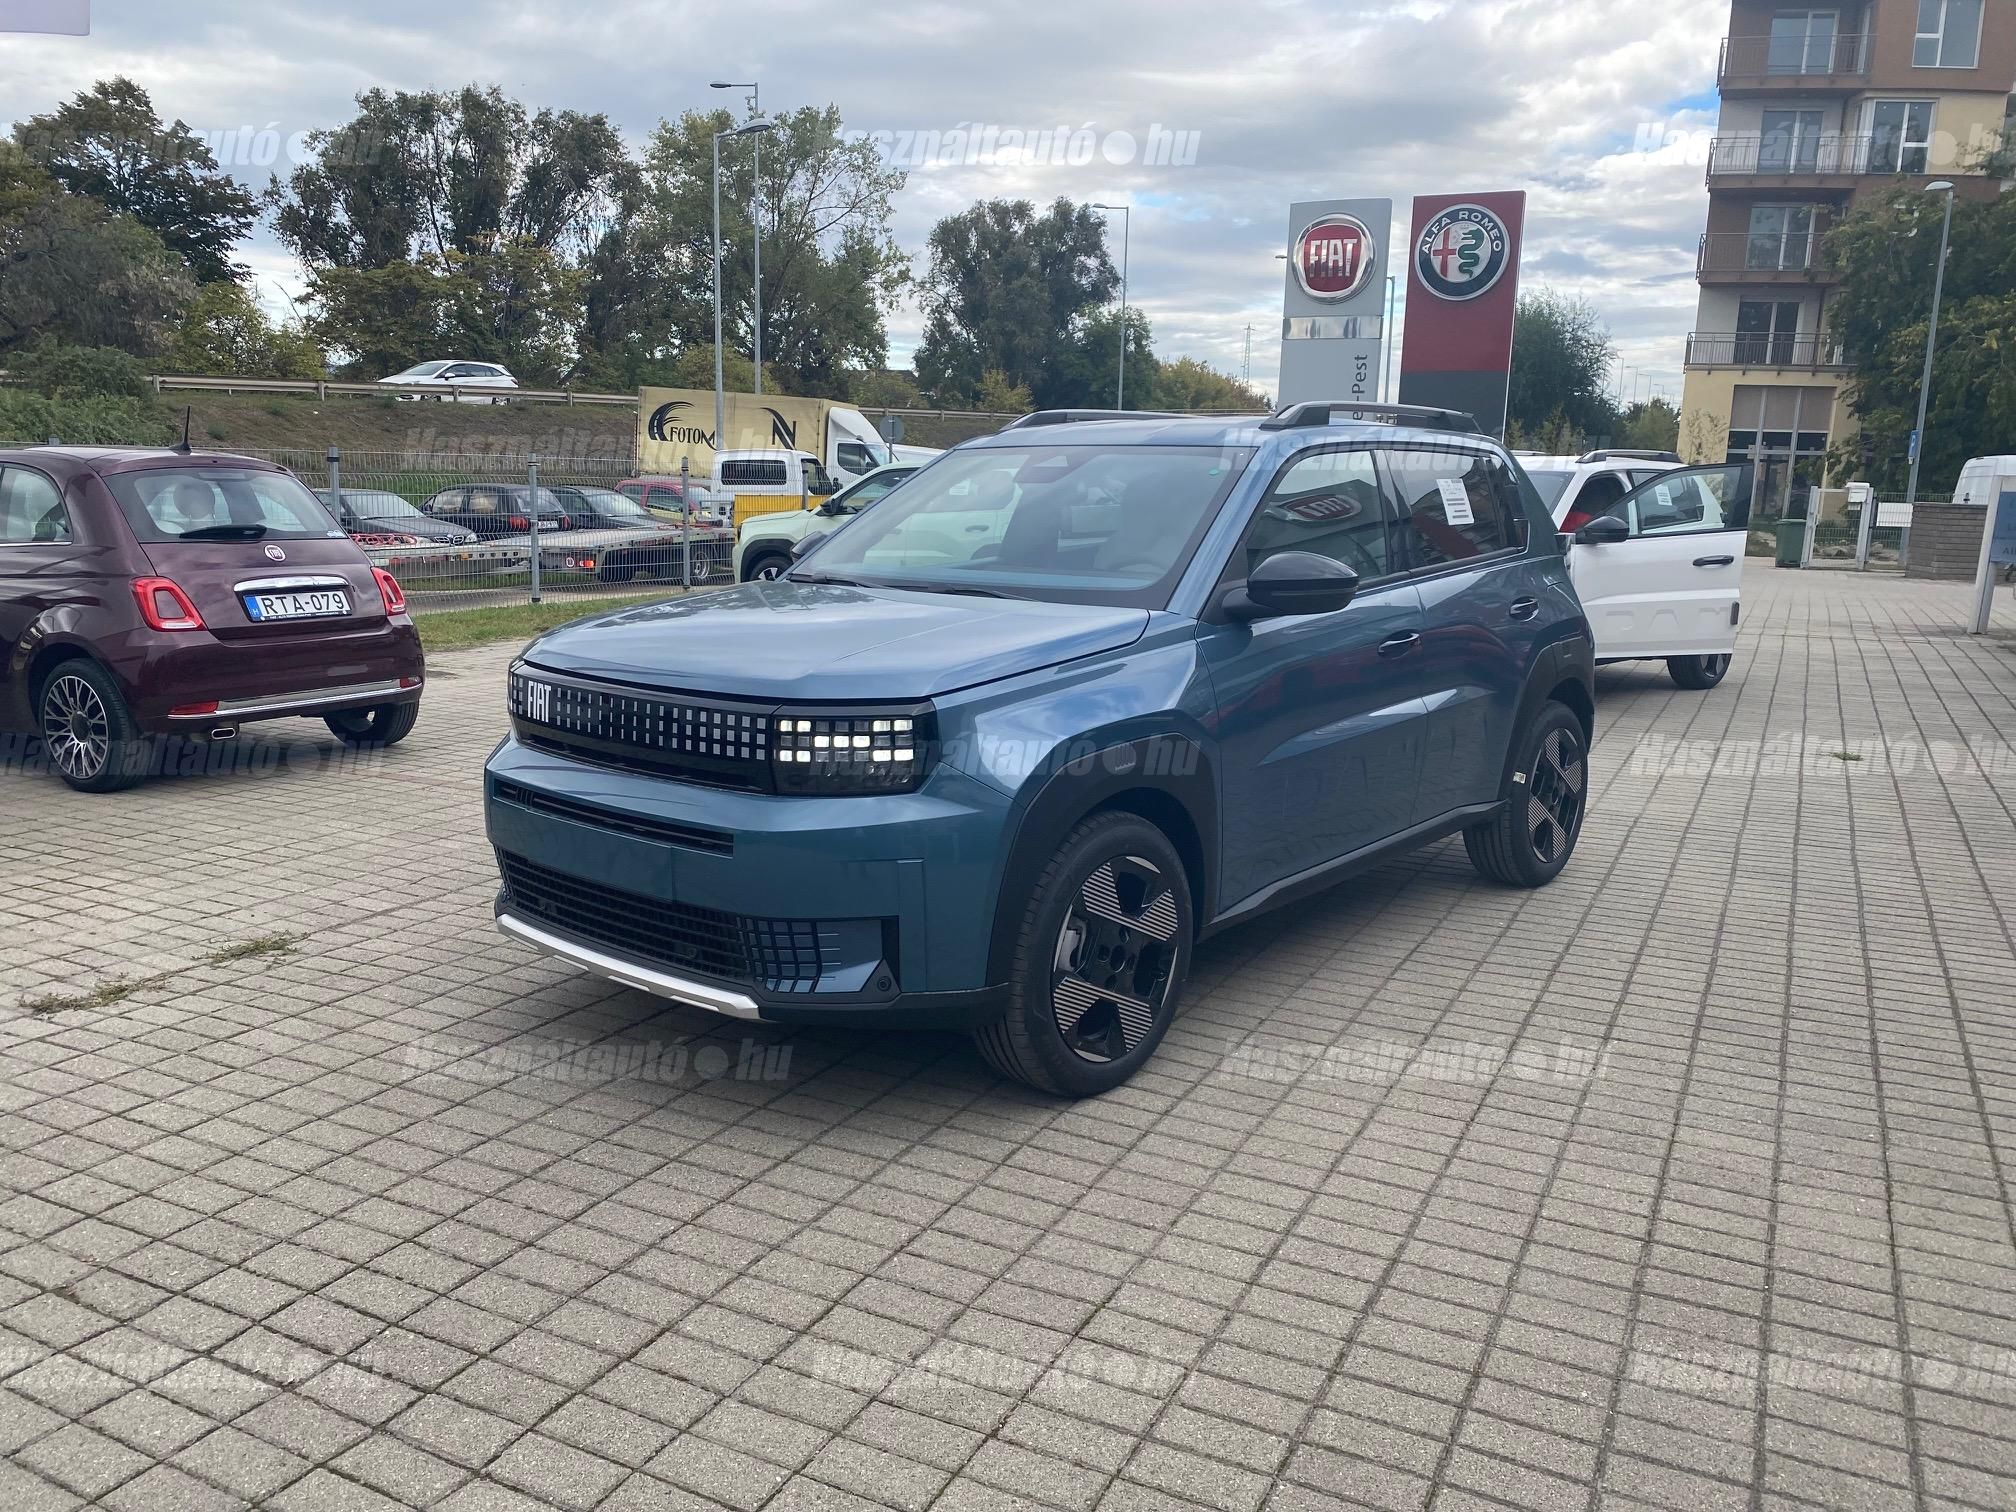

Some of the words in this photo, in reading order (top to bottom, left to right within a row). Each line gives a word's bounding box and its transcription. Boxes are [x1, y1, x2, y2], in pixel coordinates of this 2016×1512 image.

[1422, 217, 1452, 254] ALFA
[1458, 210, 1503, 253] ROMEO
[1309, 238, 1359, 279] FIAT
[261, 593, 345, 615] RTA-079
[527, 680, 551, 723] FIAT
